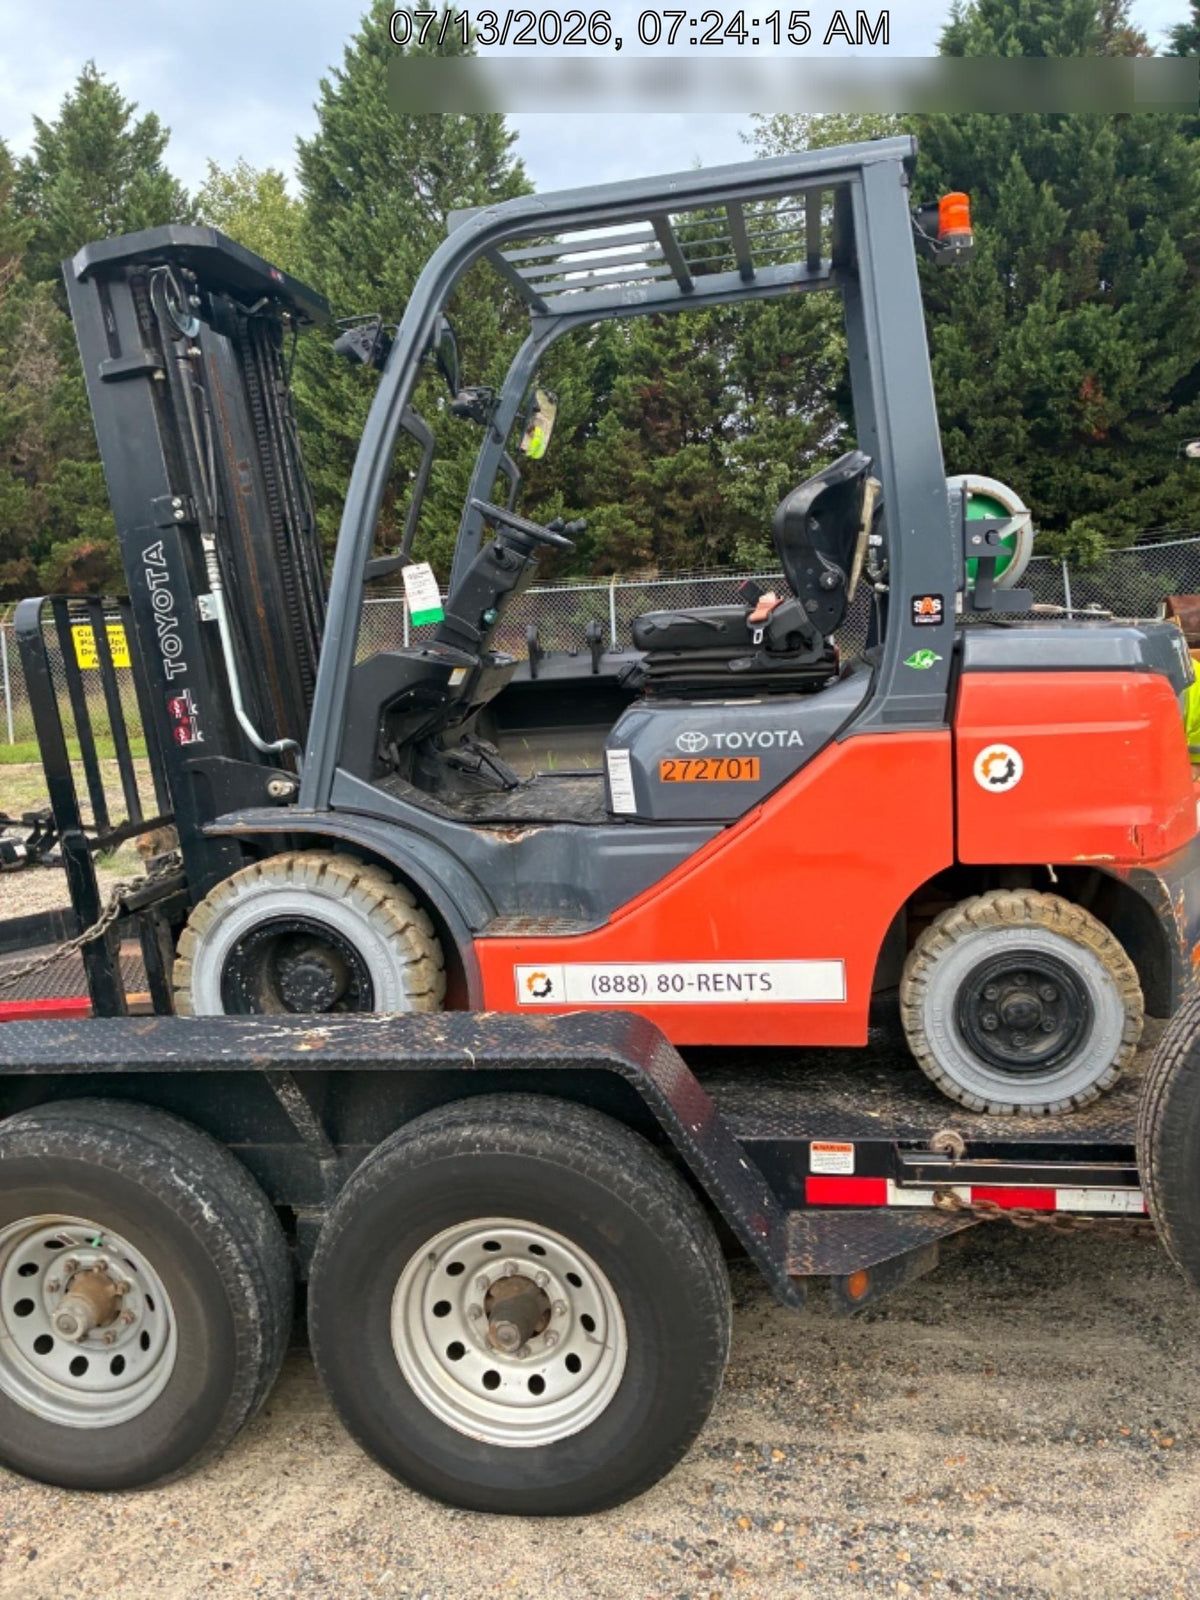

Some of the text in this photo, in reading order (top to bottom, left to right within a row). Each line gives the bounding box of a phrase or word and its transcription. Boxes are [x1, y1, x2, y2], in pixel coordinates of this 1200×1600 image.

[142, 540, 188, 680] TOYOTA
[711, 730, 804, 749] TOYOTA
[662, 758, 756, 781] 272701
[590, 972, 773, 995] (888) 80-RENTS
